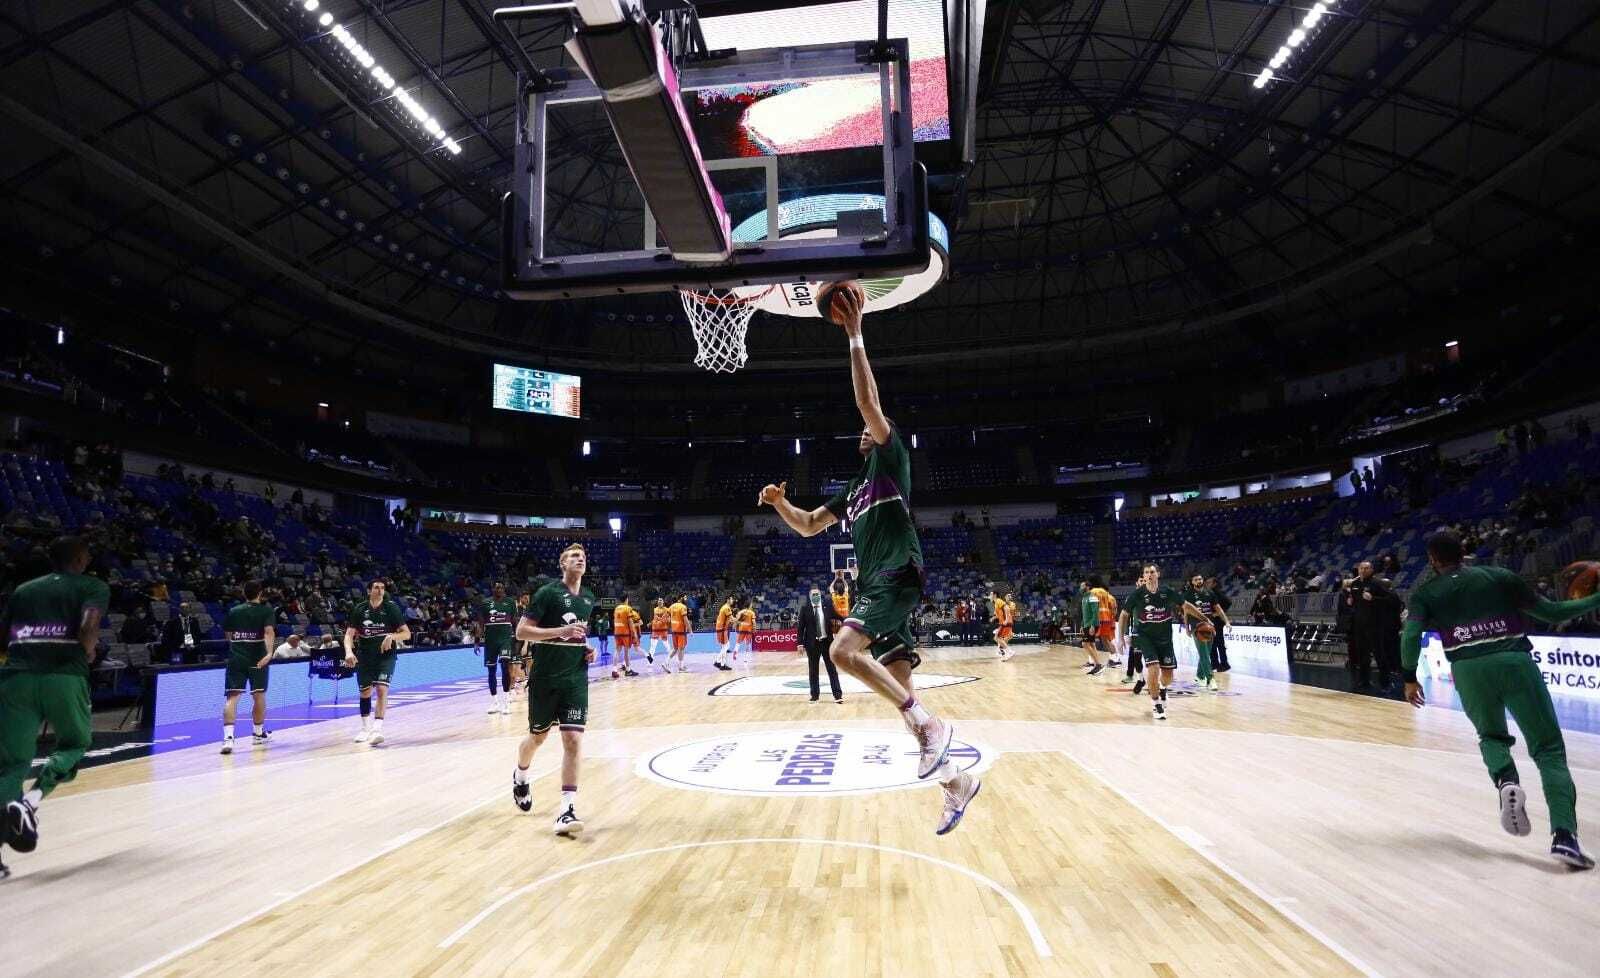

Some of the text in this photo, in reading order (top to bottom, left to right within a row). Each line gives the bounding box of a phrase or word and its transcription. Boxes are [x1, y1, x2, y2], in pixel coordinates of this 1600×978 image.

[791, 282, 813, 306] icaja
[1253, 634, 1260, 642] de
[1262, 633, 1281, 646] riesgo
[1542, 671, 1600, 690] EN CAS
[755, 749, 788, 762] LAS
[775, 733, 844, 785] PEDRIZAS
